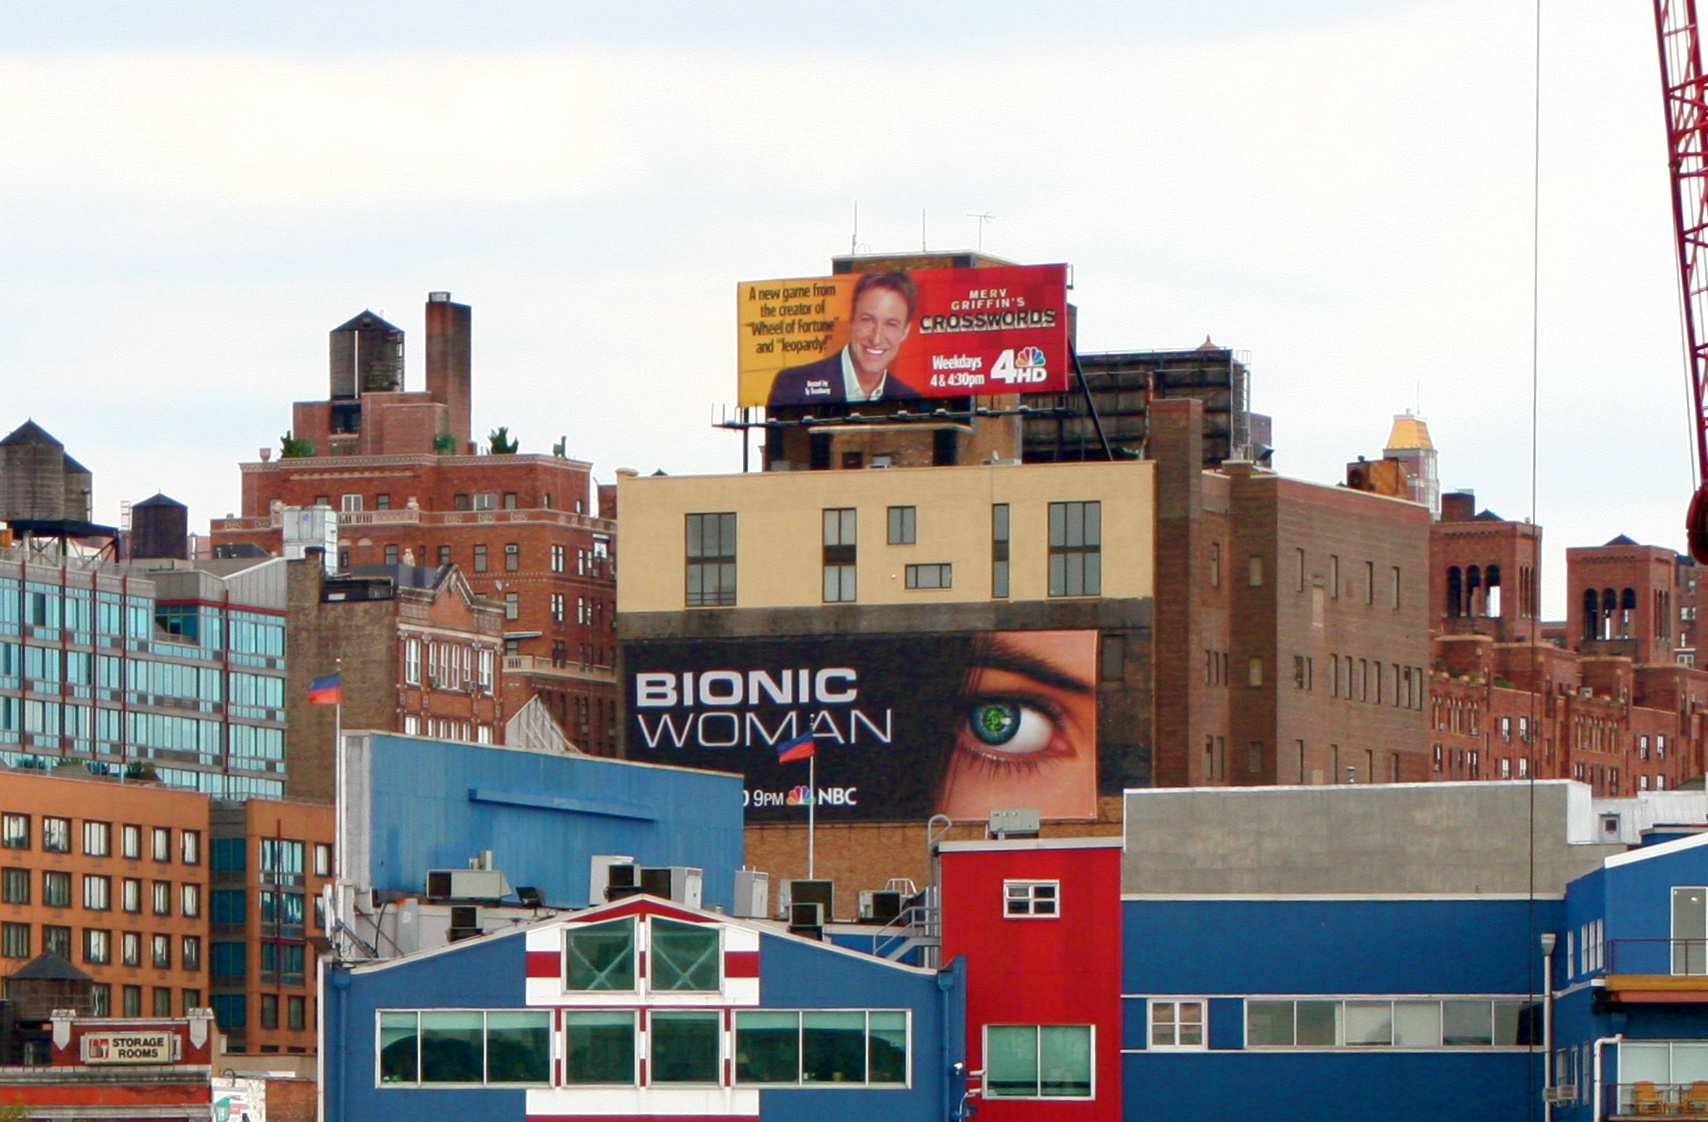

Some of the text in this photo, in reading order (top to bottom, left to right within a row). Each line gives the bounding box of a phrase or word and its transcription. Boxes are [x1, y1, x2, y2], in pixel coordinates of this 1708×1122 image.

[749, 283, 836, 302] A new game from
[969, 288, 1007, 299] MERV
[760, 299, 826, 318] the creator of
[951, 297, 1026, 311] GRIFFIN'S
[785, 320, 796, 334] of
[919, 308, 1056, 334] CROSSWORDS
[756, 338, 775, 354] and
[932, 354, 982, 371] Weekdays
[930, 372, 985, 388] 4 & 4:30pm
[636, 668, 858, 707] BIONIC
[637, 708, 892, 748] WOMAN
[753, 789, 784, 807] 9PM
[818, 787, 857, 805] NBC
[112, 1037, 164, 1048] STORAGE
[118, 1048, 159, 1059] ROOMS
